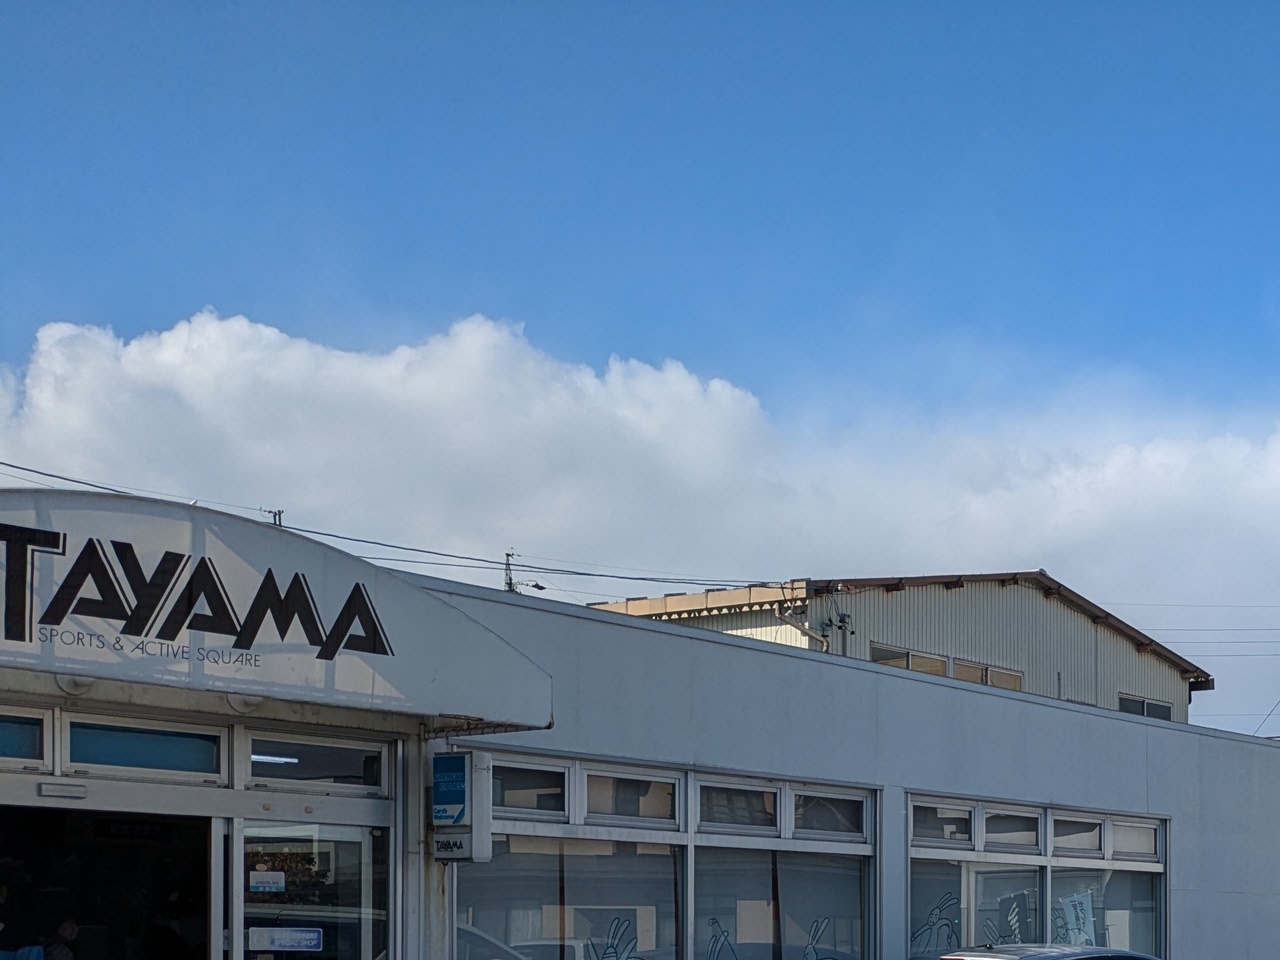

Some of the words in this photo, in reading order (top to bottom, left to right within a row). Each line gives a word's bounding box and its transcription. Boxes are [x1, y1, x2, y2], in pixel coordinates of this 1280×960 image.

[0, 523, 396, 661] TAYAMA
[38, 627, 105, 649] SPORTS
[112, 637, 125, 651] &
[130, 640, 190, 660] ACTIVE
[196, 648, 262, 668] SQUARE
[435, 840, 464, 852] TAYAMA
